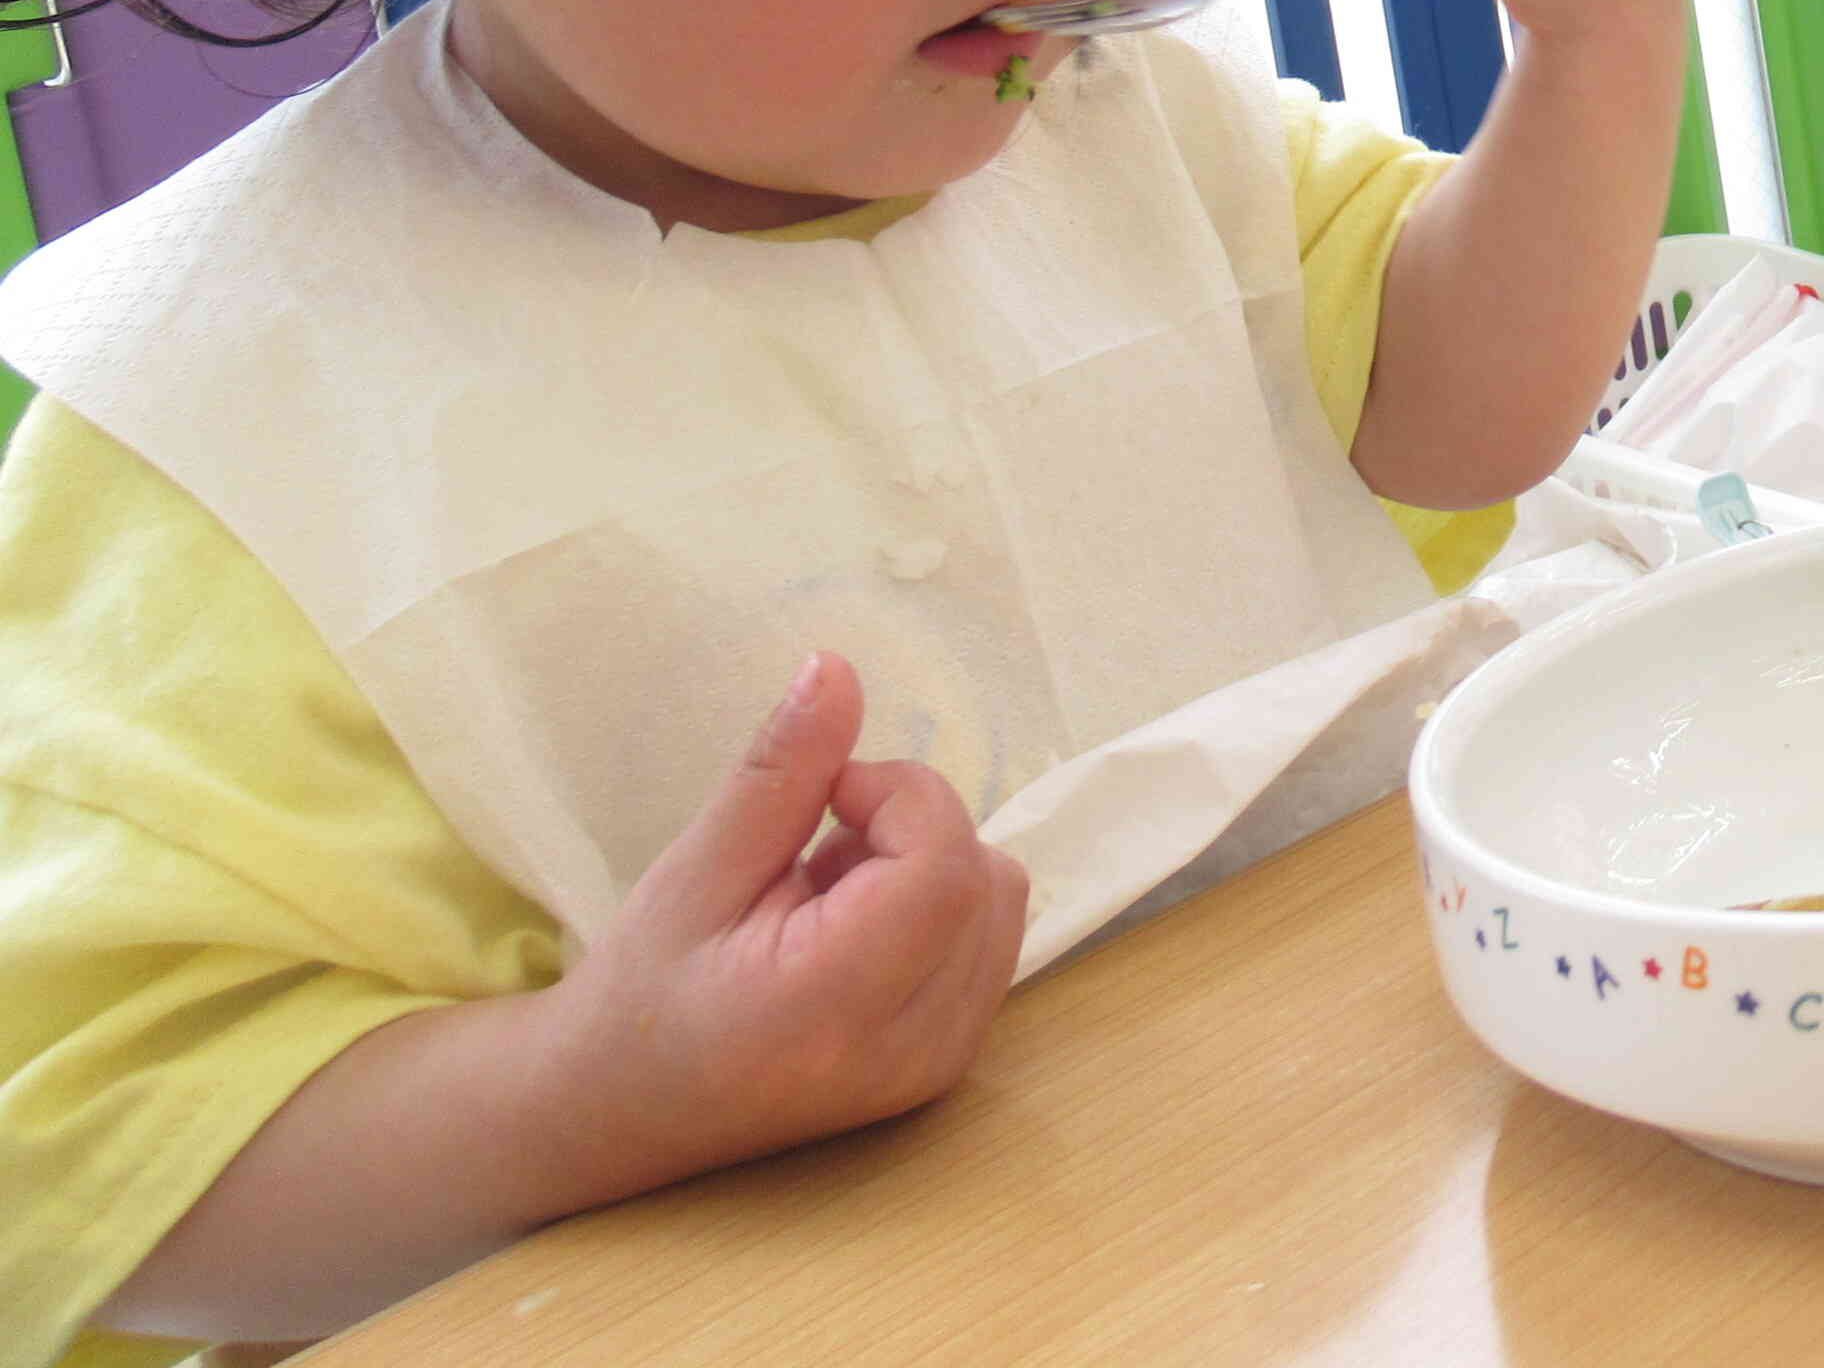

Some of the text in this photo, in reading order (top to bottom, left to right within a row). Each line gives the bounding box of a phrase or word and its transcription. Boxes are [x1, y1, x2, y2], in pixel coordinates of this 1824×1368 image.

[1493, 907, 1519, 950] Z
[1592, 956, 1619, 1000] A
[1682, 947, 1708, 990] B
[1789, 992, 1823, 1032] C
